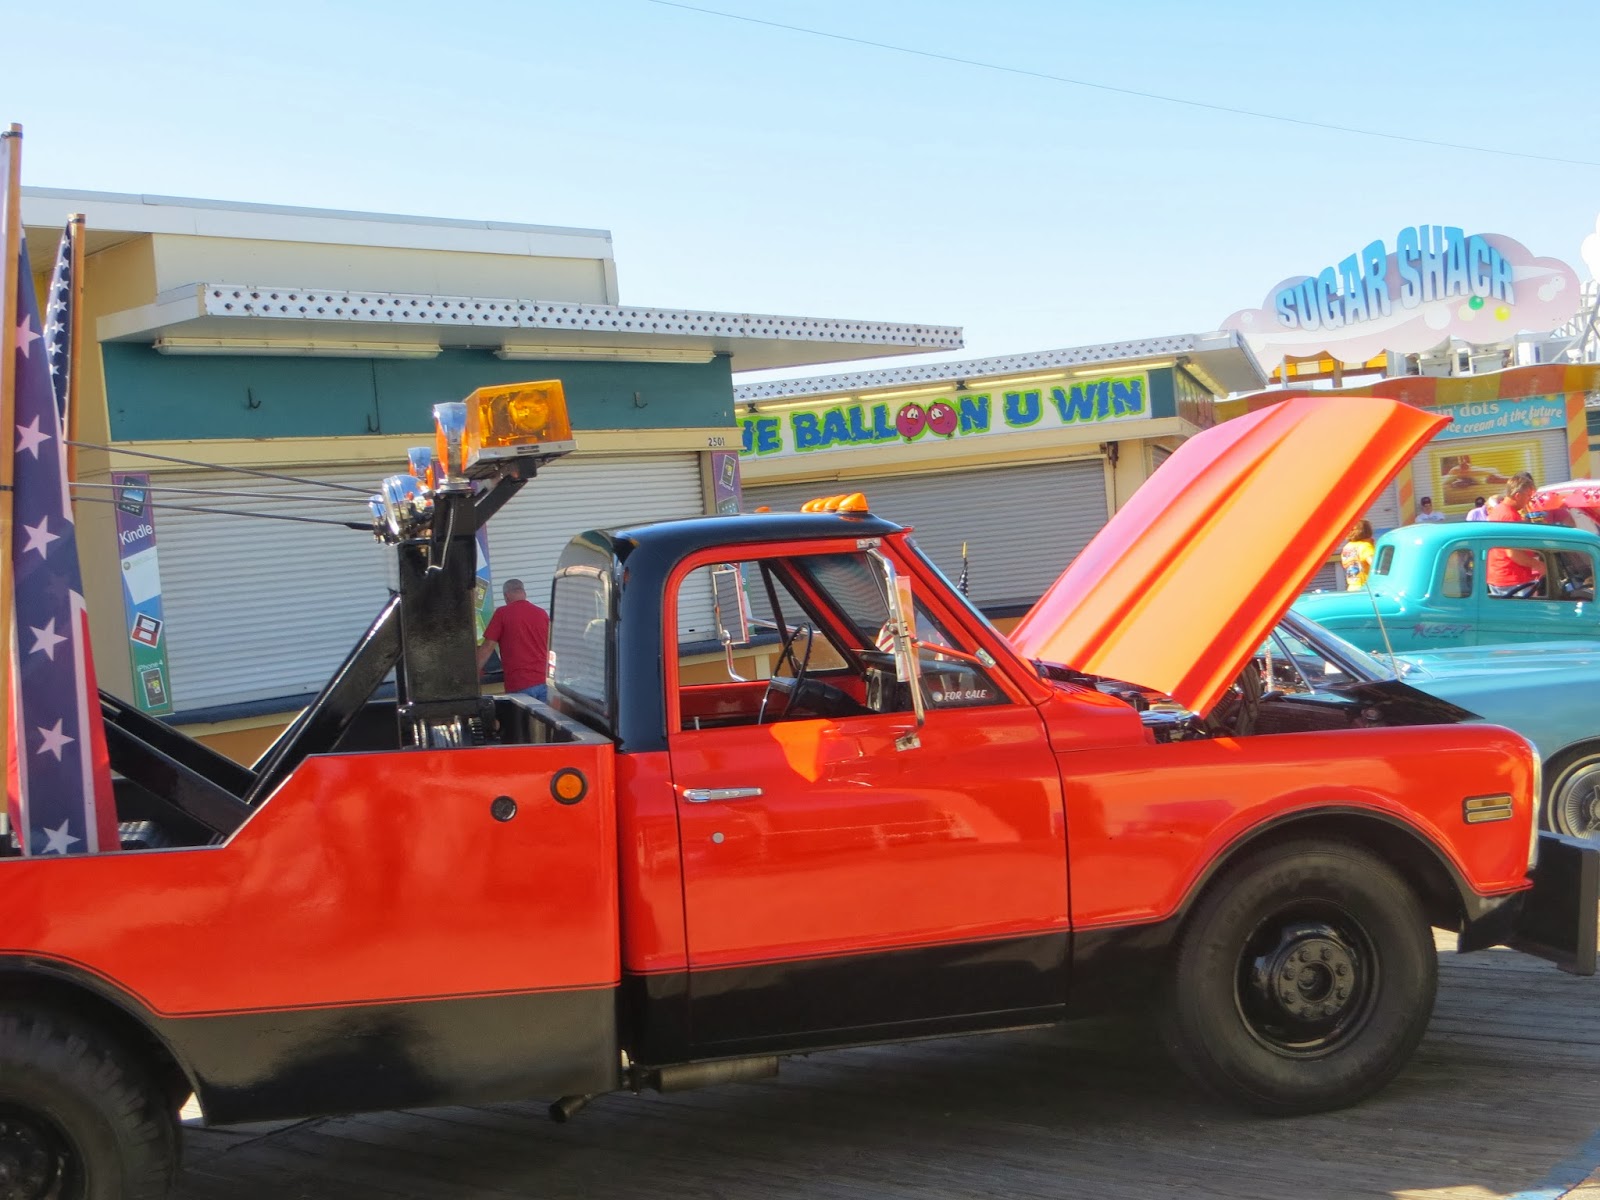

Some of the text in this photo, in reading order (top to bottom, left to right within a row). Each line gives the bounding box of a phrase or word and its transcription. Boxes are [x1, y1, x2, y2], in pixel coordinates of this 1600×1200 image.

[1276, 224, 1516, 331] SUGAR SHACK
[1005, 391, 1040, 425] U
[1051, 379, 1142, 422] WIN
[1460, 402, 1500, 418] dots
[1463, 419, 1495, 434] cream
[1497, 412, 1508, 427] of
[1510, 407, 1527, 423] the
[1529, 404, 1563, 420] future
[707, 437, 725, 447] 2501
[119, 523, 153, 545] Kindle
[944, 689, 987, 701] FOR SALE
